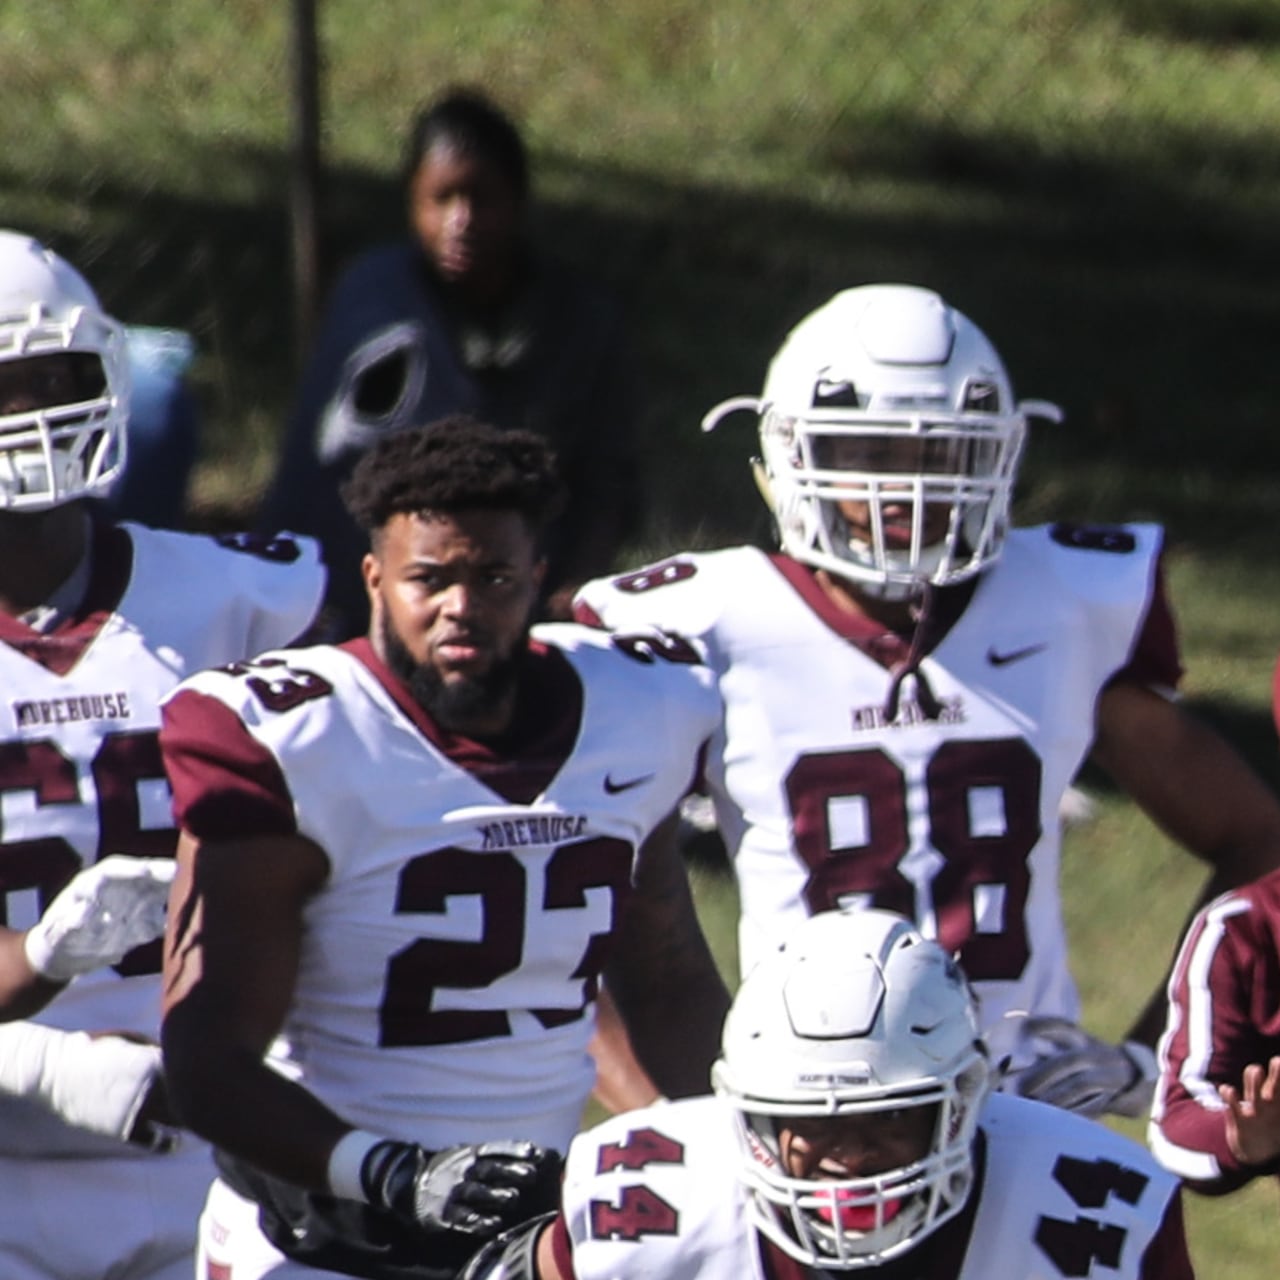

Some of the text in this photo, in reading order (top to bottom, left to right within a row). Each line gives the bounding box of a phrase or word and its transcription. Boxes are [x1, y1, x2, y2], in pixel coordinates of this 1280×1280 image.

[13, 693, 131, 727] MOREHOUSE
[784, 737, 1042, 981] 88
[379, 836, 638, 1048] 23
[589, 1127, 685, 1242] 44
[1033, 1153, 1152, 1278] 44
